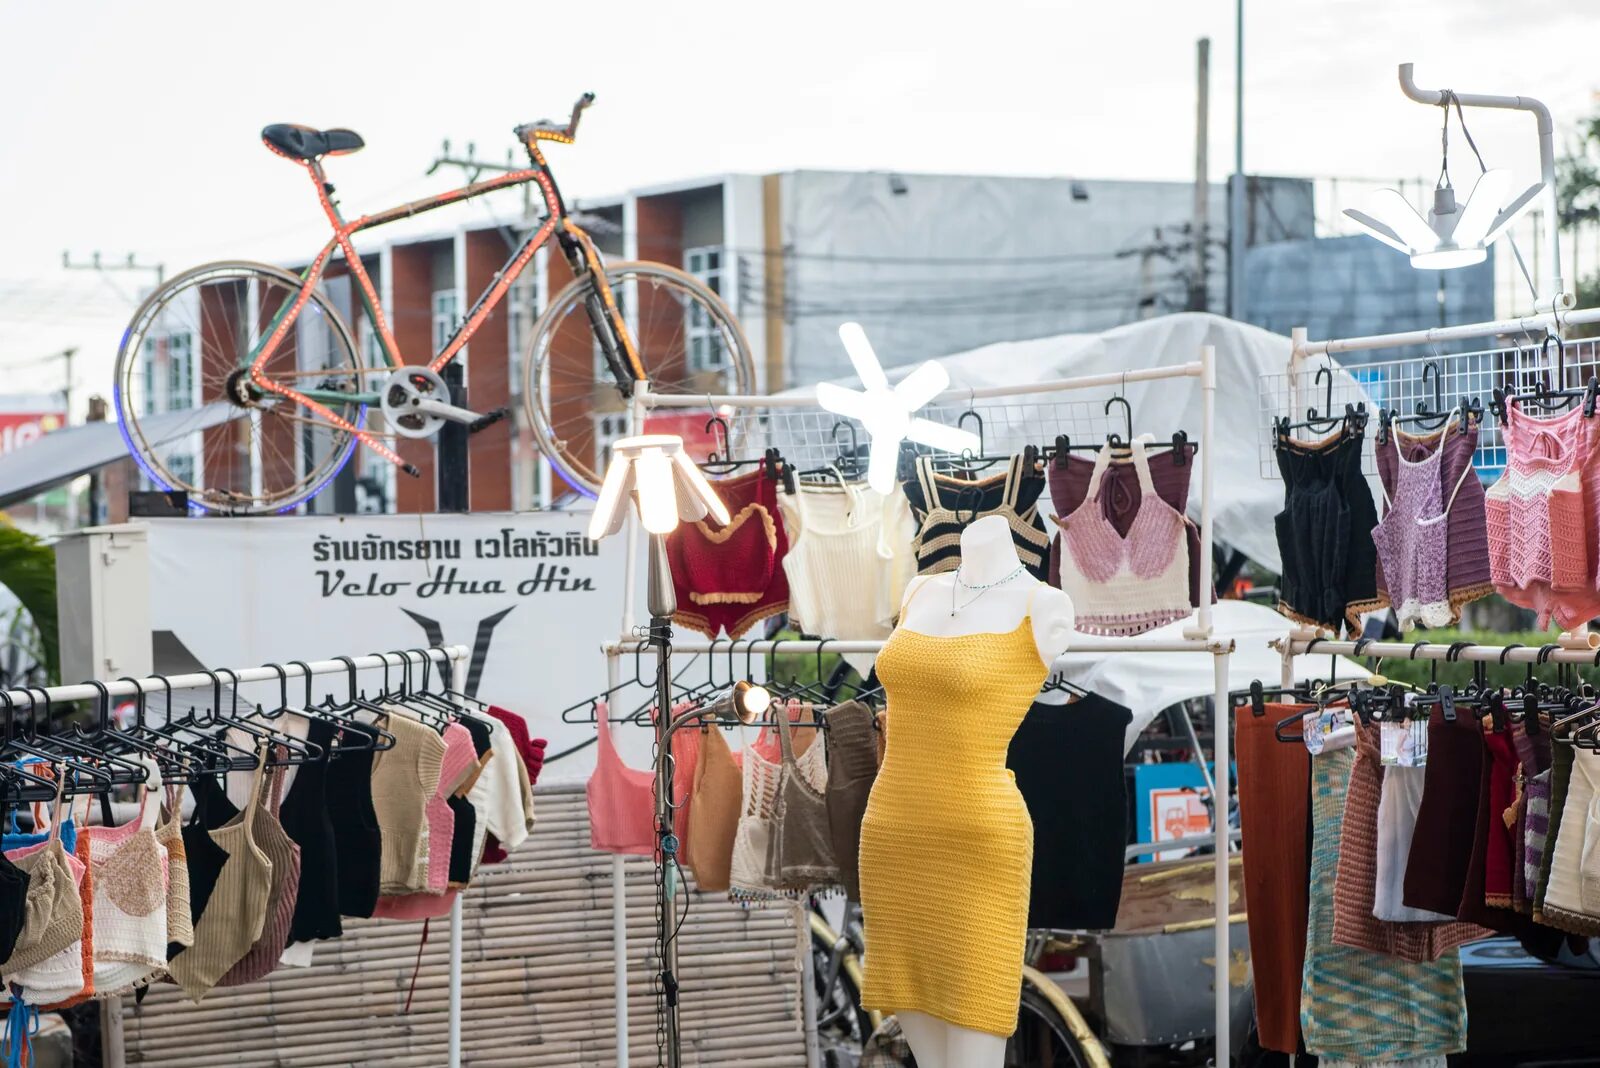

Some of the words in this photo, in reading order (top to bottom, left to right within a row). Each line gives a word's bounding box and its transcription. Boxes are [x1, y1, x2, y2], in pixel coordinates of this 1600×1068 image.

[314, 533, 461, 561] ร้านจักรยาน
[475, 528, 599, 558] เวโลหัวหิน
[315, 569, 411, 597] Velo
[416, 565, 506, 598] Hua
[517, 563, 597, 596] Hin
